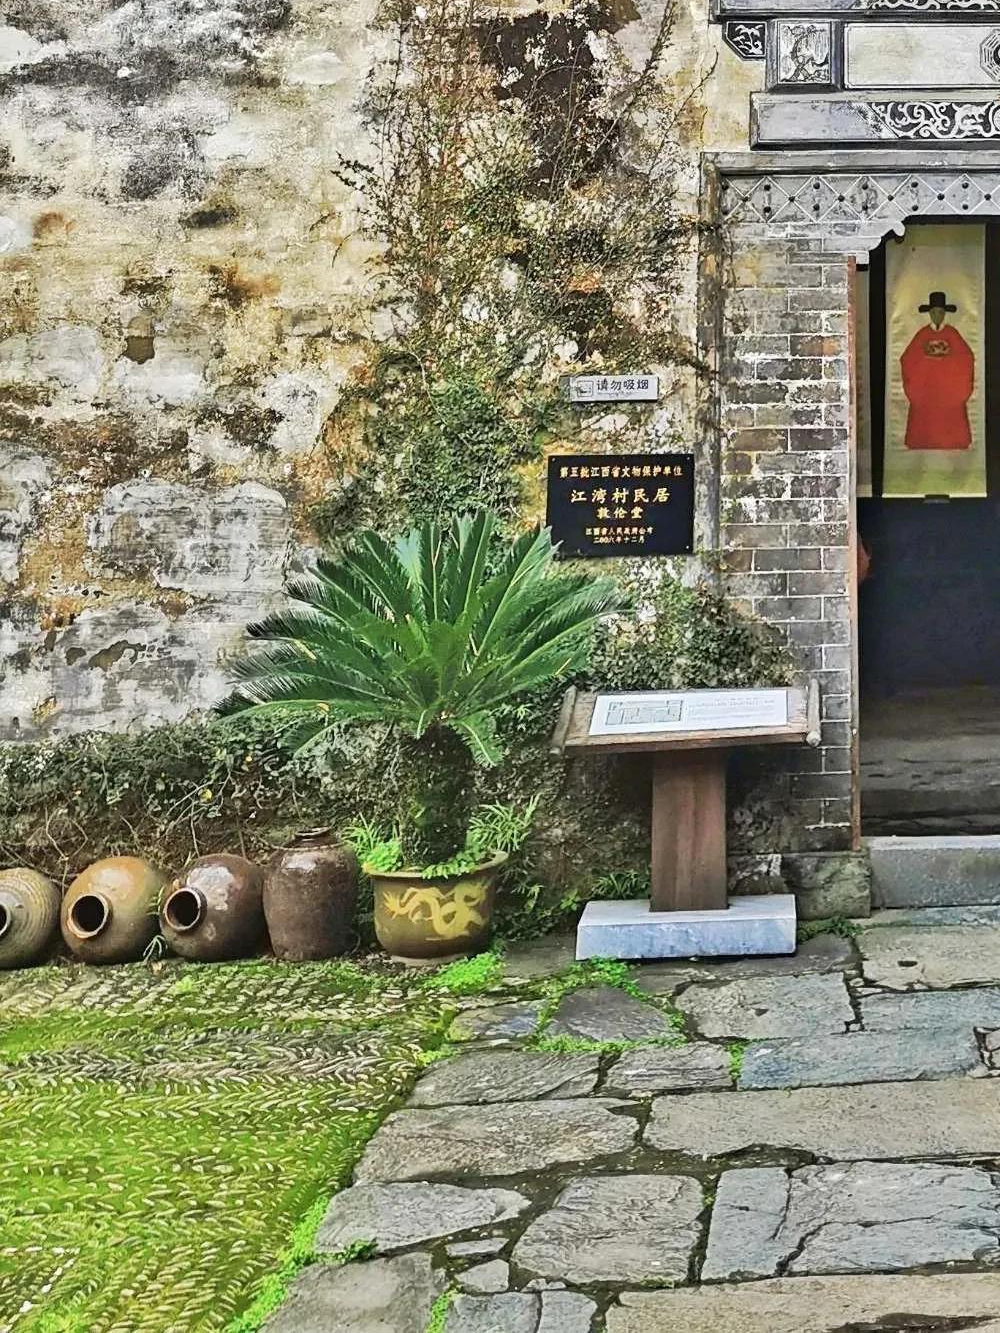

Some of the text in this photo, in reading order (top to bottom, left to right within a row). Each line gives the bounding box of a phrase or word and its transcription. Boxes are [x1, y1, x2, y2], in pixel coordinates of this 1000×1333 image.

[597, 378, 649, 391] 请勿吸烟
[570, 488, 670, 503] 江湾村民居
[596, 507, 644, 519] 敦伦堂
